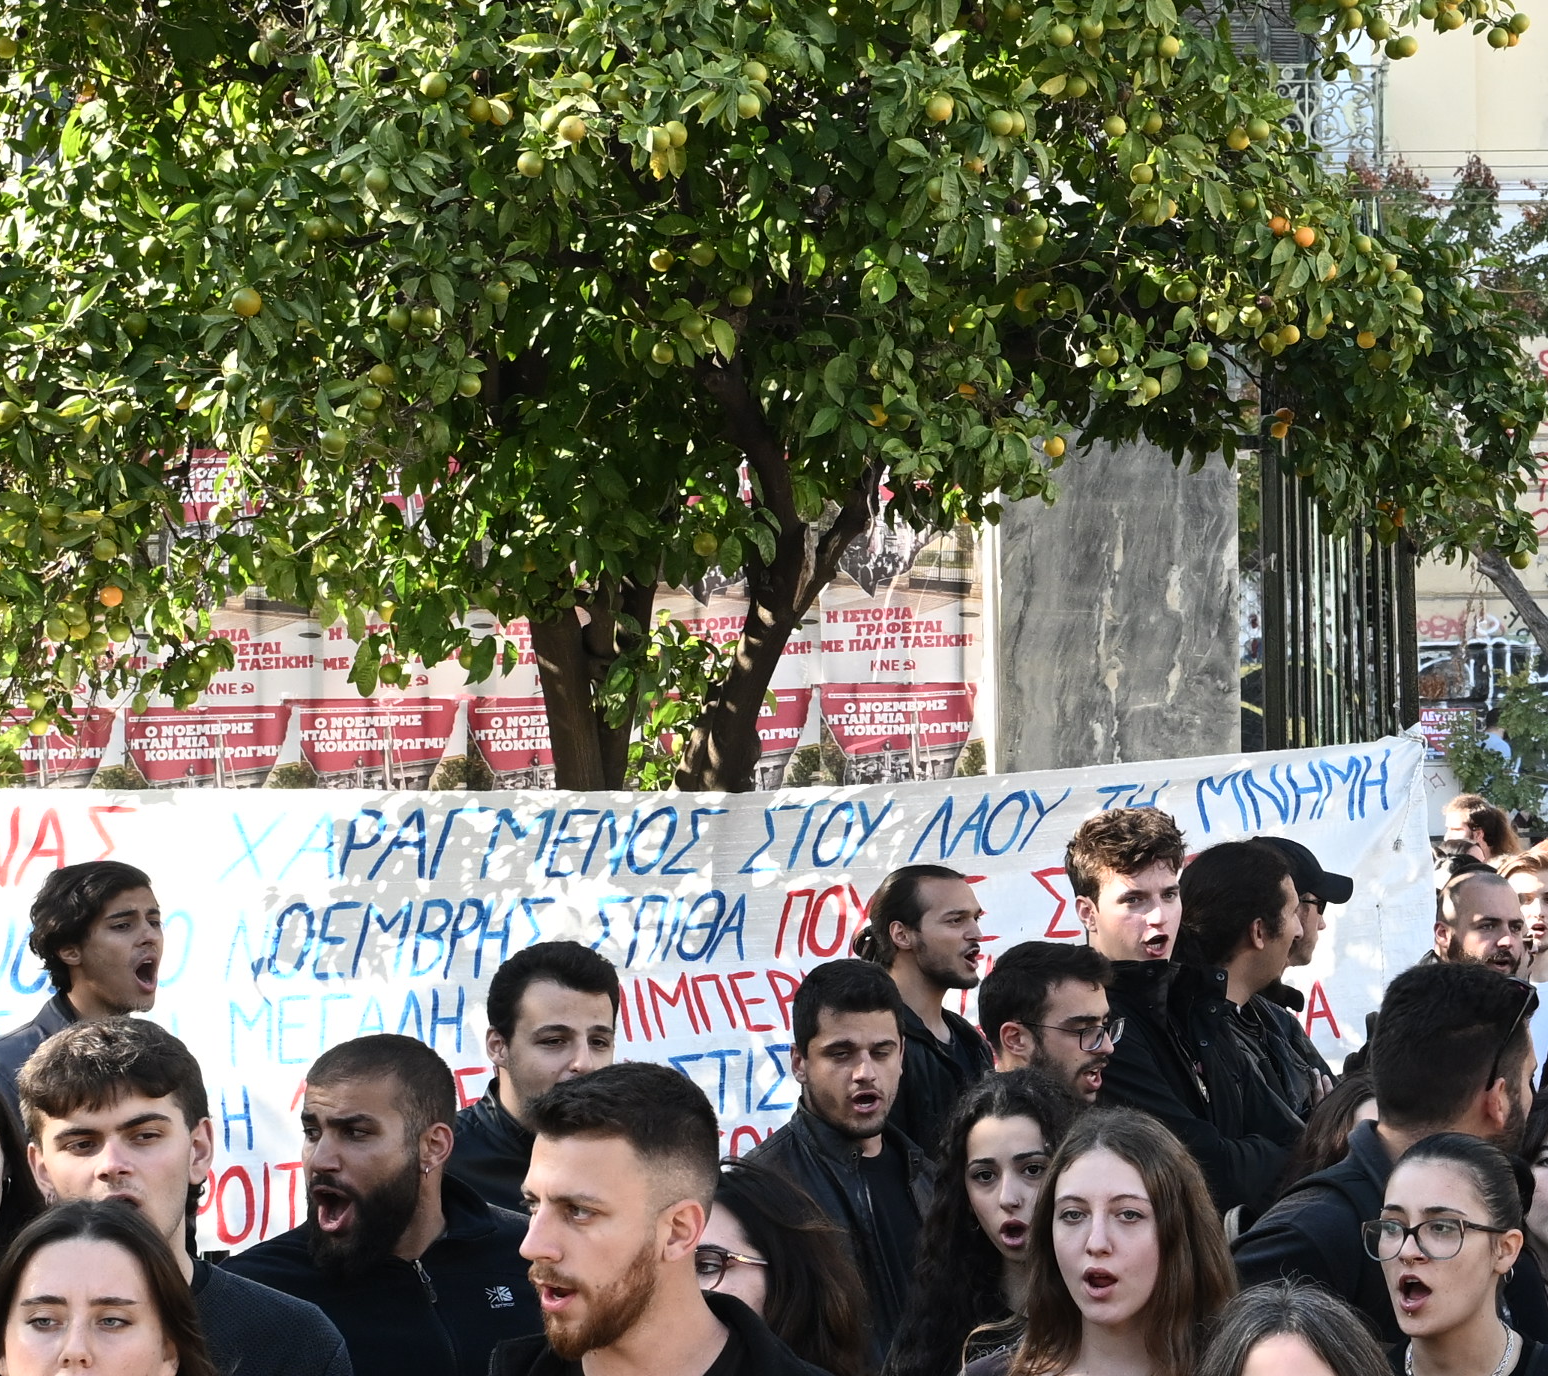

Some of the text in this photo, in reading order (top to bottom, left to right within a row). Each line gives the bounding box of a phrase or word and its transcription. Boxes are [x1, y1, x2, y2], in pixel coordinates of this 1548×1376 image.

[218, 804, 728, 882] ΧΑΡΑΓΜΕΝΟΣ
[738, 799, 894, 873] ΣΤΟΥ
[909, 787, 1071, 861] ΛΑΟΥ
[1196, 749, 1391, 833] ΜΝΗΜΗ
[225, 897, 555, 982] ΝΟΕΜΒΡΗΣ
[591, 890, 746, 969] ΣΠΙΘΑ
[229, 986, 465, 1068] ΜΕΓΑΛΗ
